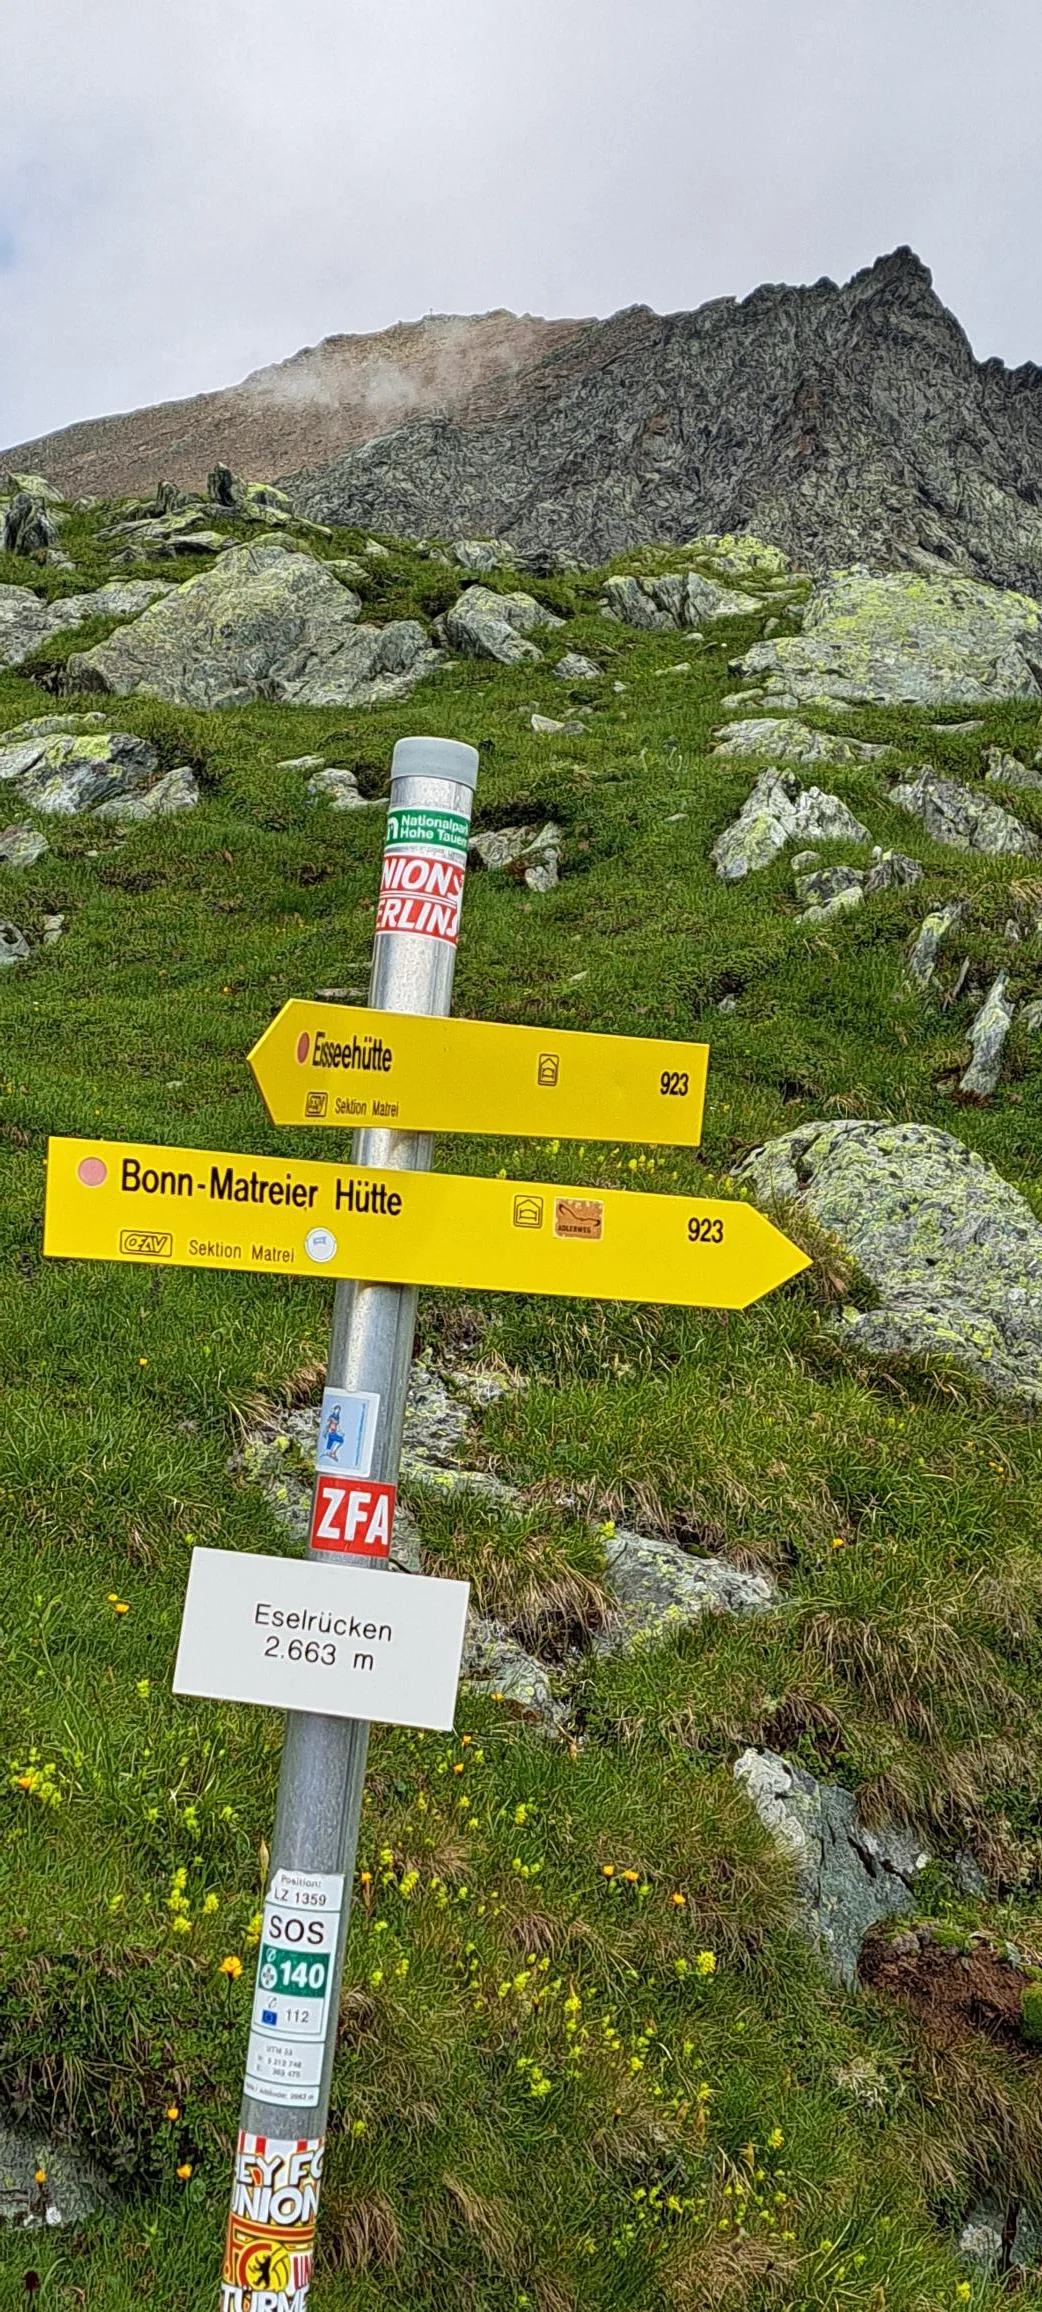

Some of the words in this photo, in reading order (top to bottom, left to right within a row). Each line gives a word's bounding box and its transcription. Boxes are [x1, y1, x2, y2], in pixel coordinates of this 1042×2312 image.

[400, 826, 434, 839] Hohe
[311, 1031, 393, 1073] Eisseehütte
[660, 1070, 689, 1097] 923
[334, 1097, 367, 1116] Sektion
[372, 1099, 399, 1118] Matrei
[121, 1158, 318, 1208] Bonn-Matreier
[335, 1178, 402, 1216] Hütte
[687, 1217, 724, 1243] 923
[188, 1239, 242, 1259] Sektion
[251, 1244, 295, 1263] Matrei
[316, 1487, 389, 1546] ZFA
[254, 1603, 393, 1642] Eselrücken
[264, 1636, 337, 1667] 2.663
[353, 1651, 374, 1671] m
[281, 1874, 322, 1888] Position:
[274, 1887, 289, 1901] LZ
[295, 1891, 327, 1906] 1359
[269, 1914, 325, 1945] SOS
[280, 1959, 325, 1990] 140
[286, 2008, 309, 2023] 112
[235, 2153, 282, 2186] EY
